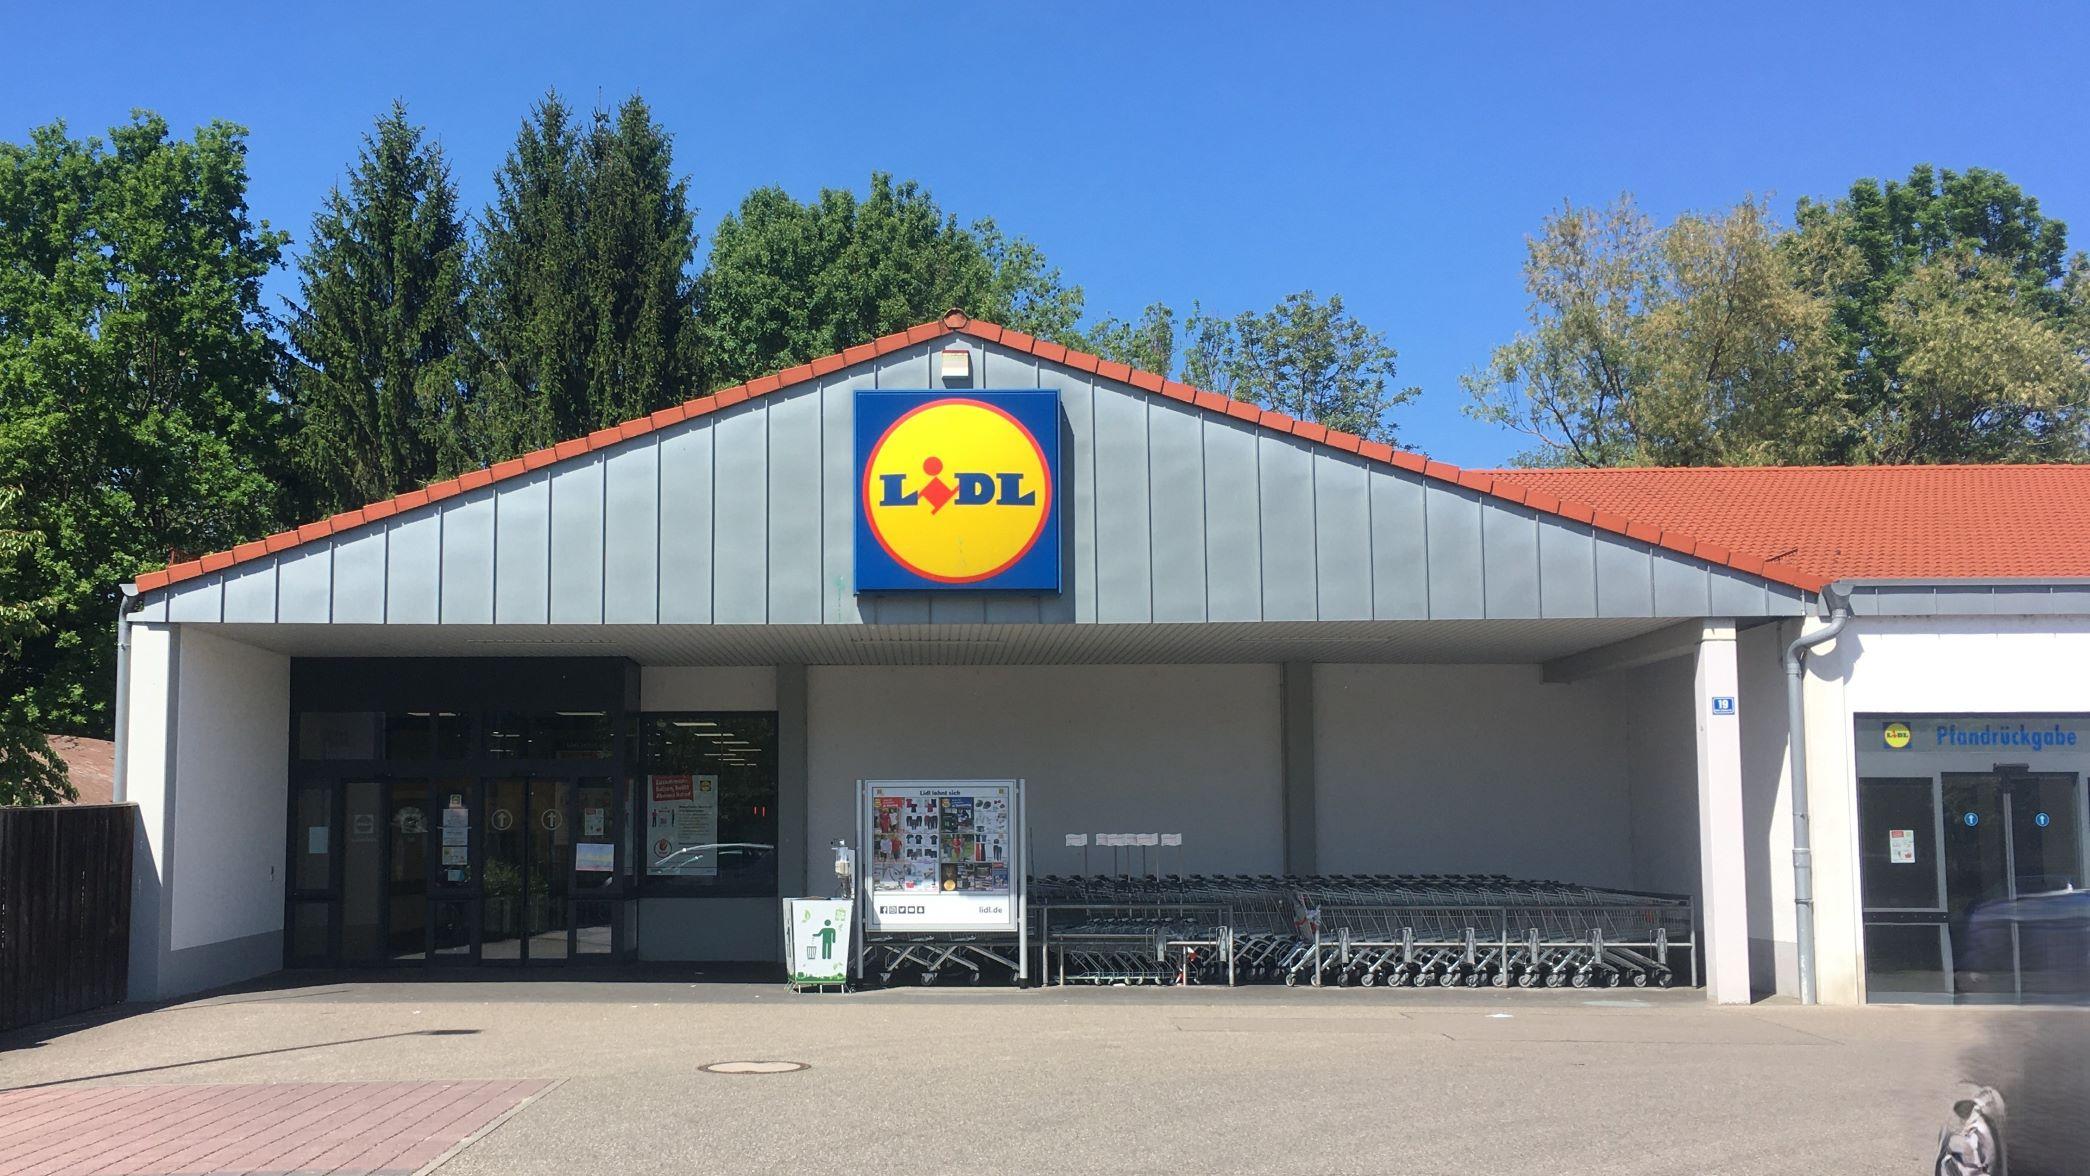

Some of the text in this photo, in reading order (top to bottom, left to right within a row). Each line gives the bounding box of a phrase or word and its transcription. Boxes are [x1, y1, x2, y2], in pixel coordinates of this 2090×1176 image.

[1717, 699, 1729, 710] 19
[1936, 724, 2077, 752] Pfandrückgabe
[978, 906, 1003, 914] lidl.de
